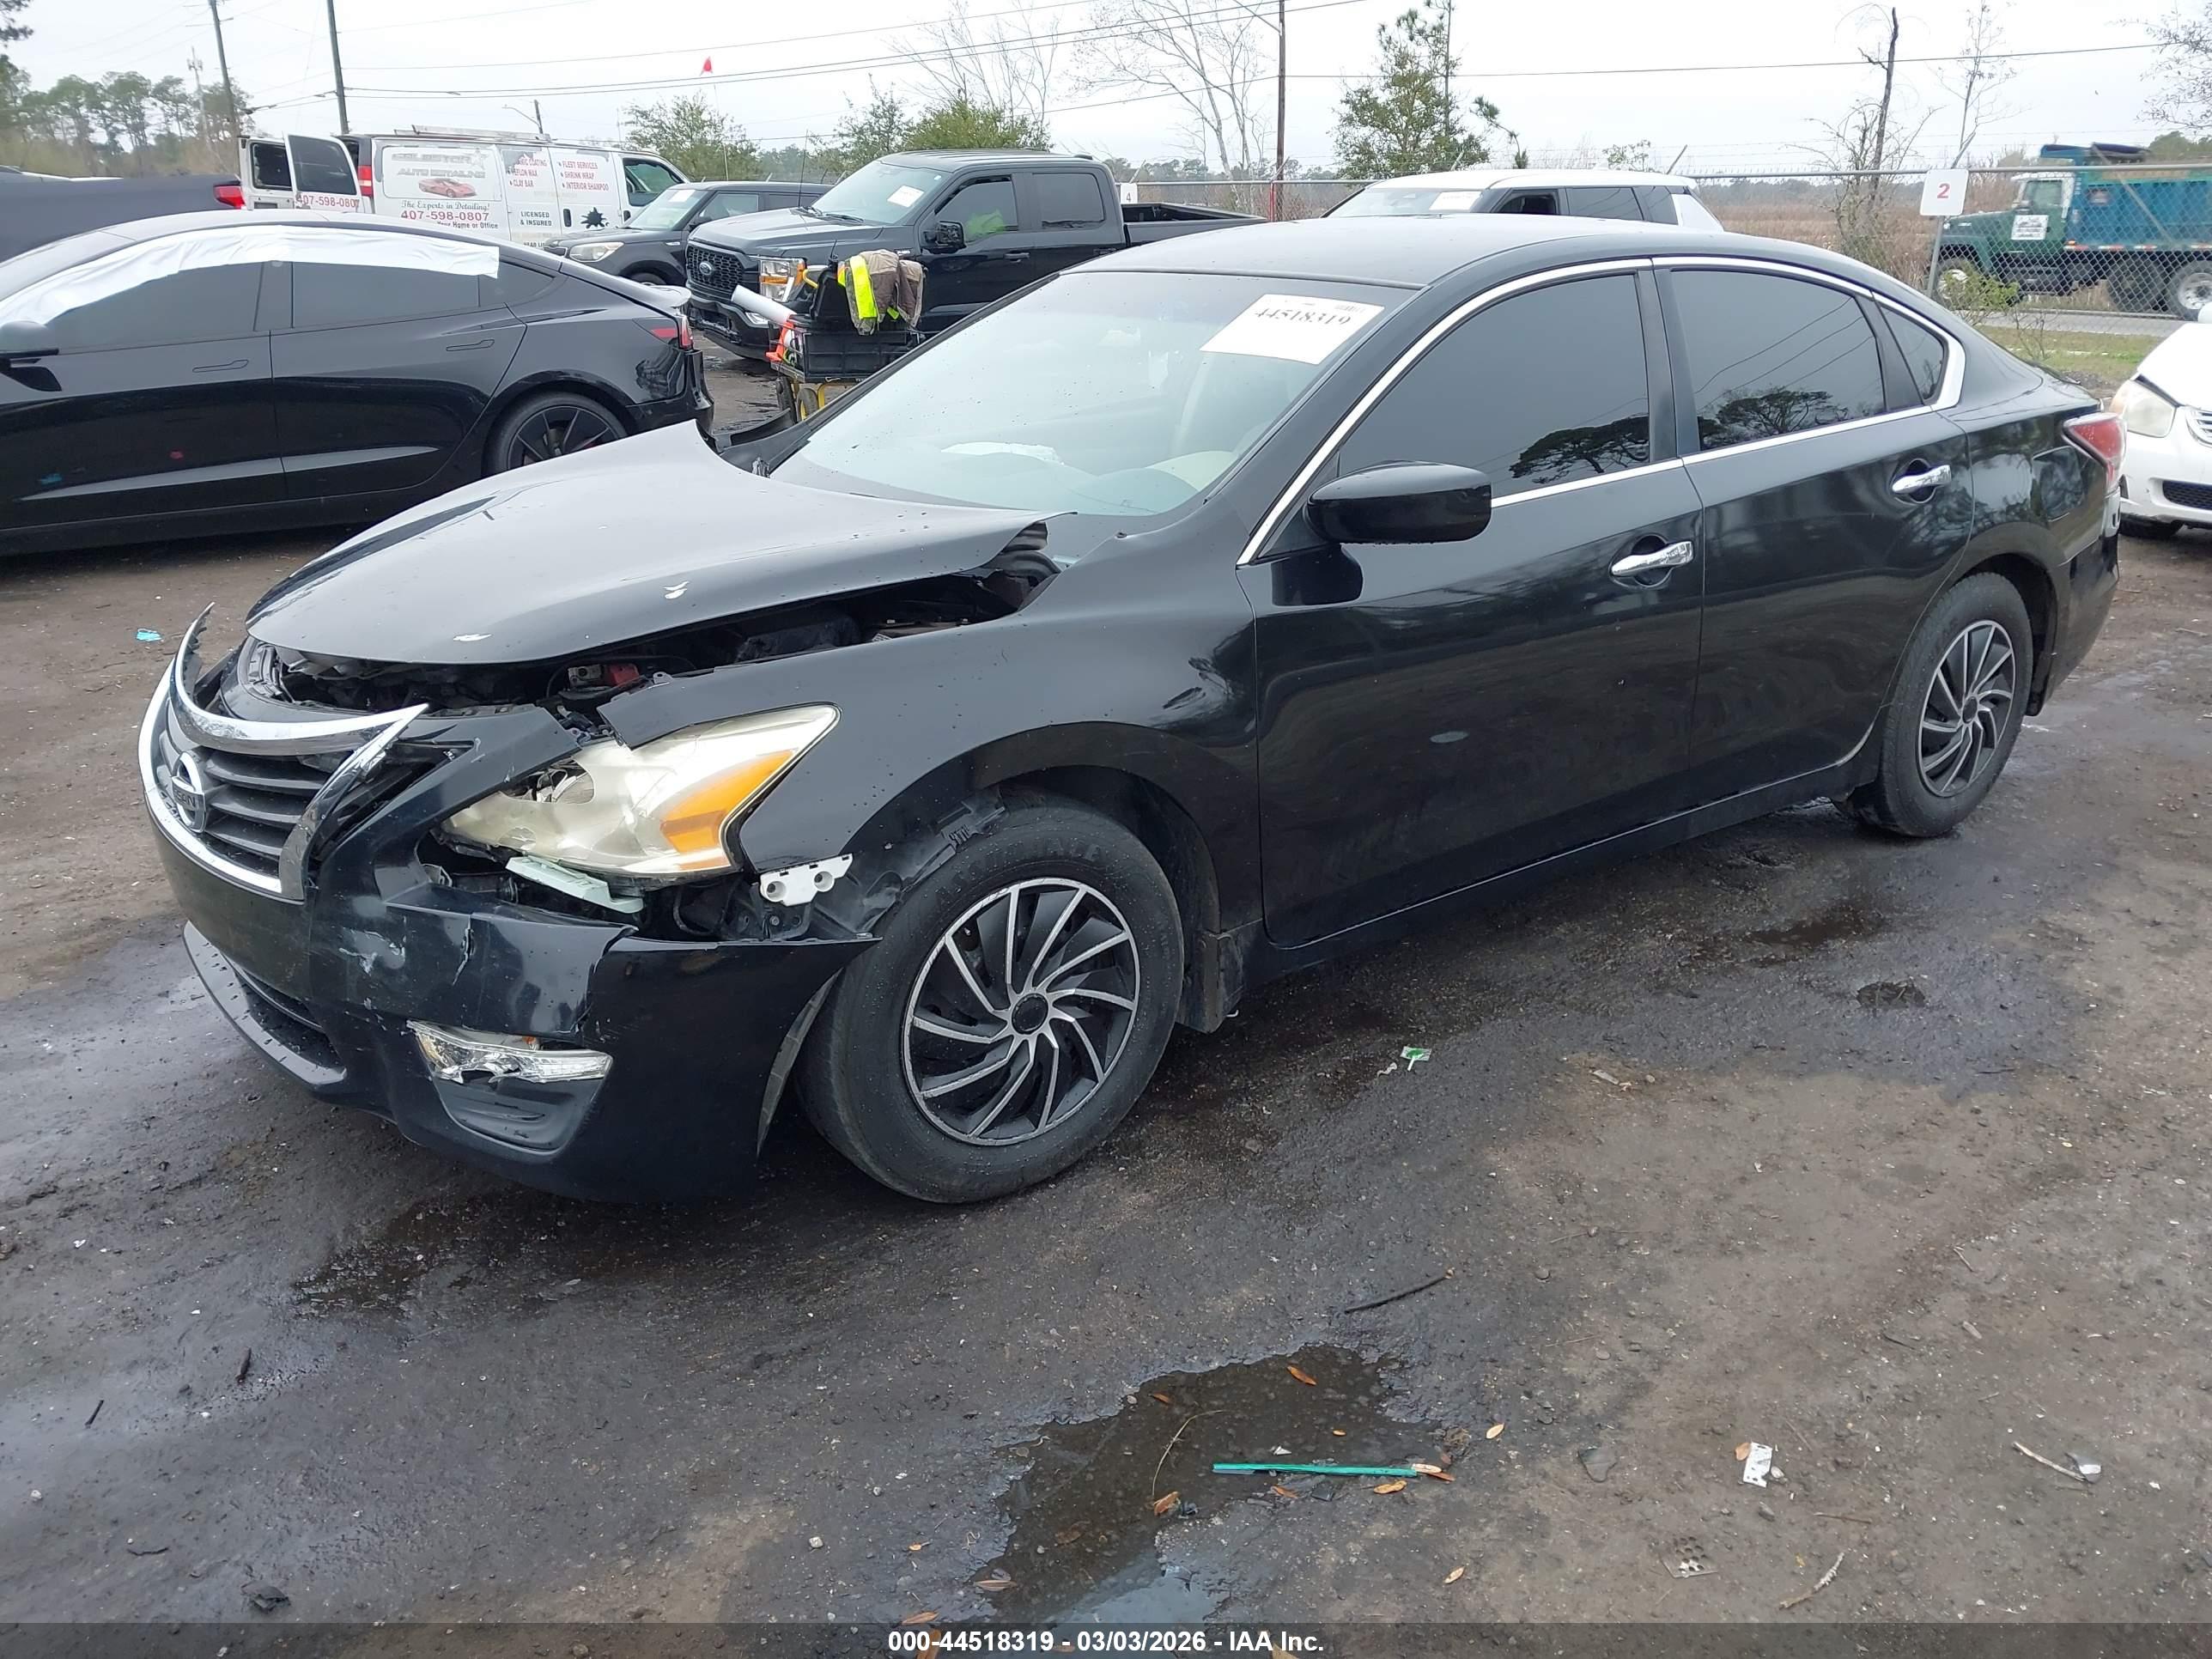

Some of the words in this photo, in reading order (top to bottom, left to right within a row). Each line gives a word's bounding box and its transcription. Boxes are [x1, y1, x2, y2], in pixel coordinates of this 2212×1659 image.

[398, 167, 428, 177] AUTO
[566, 181, 586, 191] INTERIOR
[587, 182, 609, 191] SHAMPOO
[1937, 183, 1950, 198] 2
[1127, 192, 1131, 201] 4
[416, 201, 444, 211] Experts
[454, 202, 490, 212] Detailing!
[400, 210, 489, 222] 407-598-0807
[1255, 307, 1352, 325] 44518319
